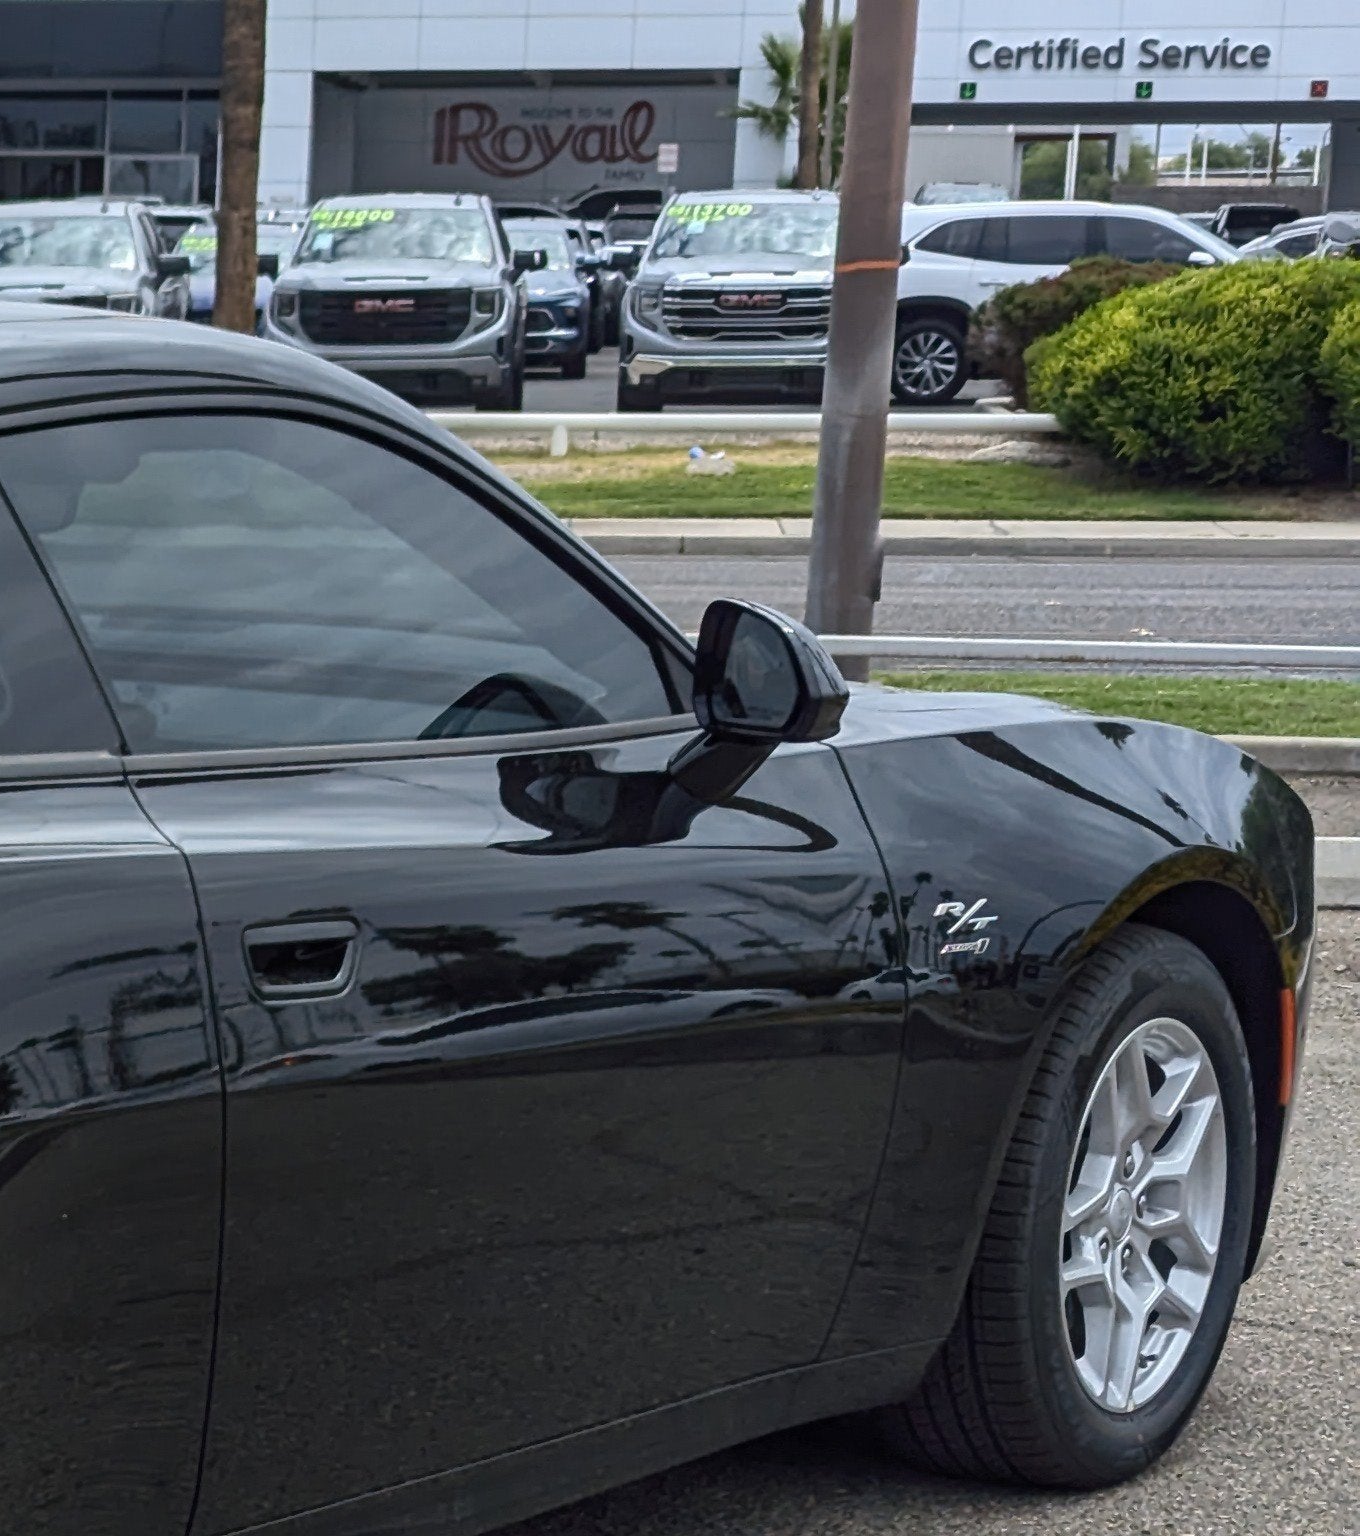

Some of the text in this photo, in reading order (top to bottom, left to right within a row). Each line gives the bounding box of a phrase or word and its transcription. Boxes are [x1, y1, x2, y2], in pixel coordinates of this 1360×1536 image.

[968, 37, 1271, 71] Certified Service
[432, 99, 659, 179] Royal
[932, 897, 999, 935] R/T
